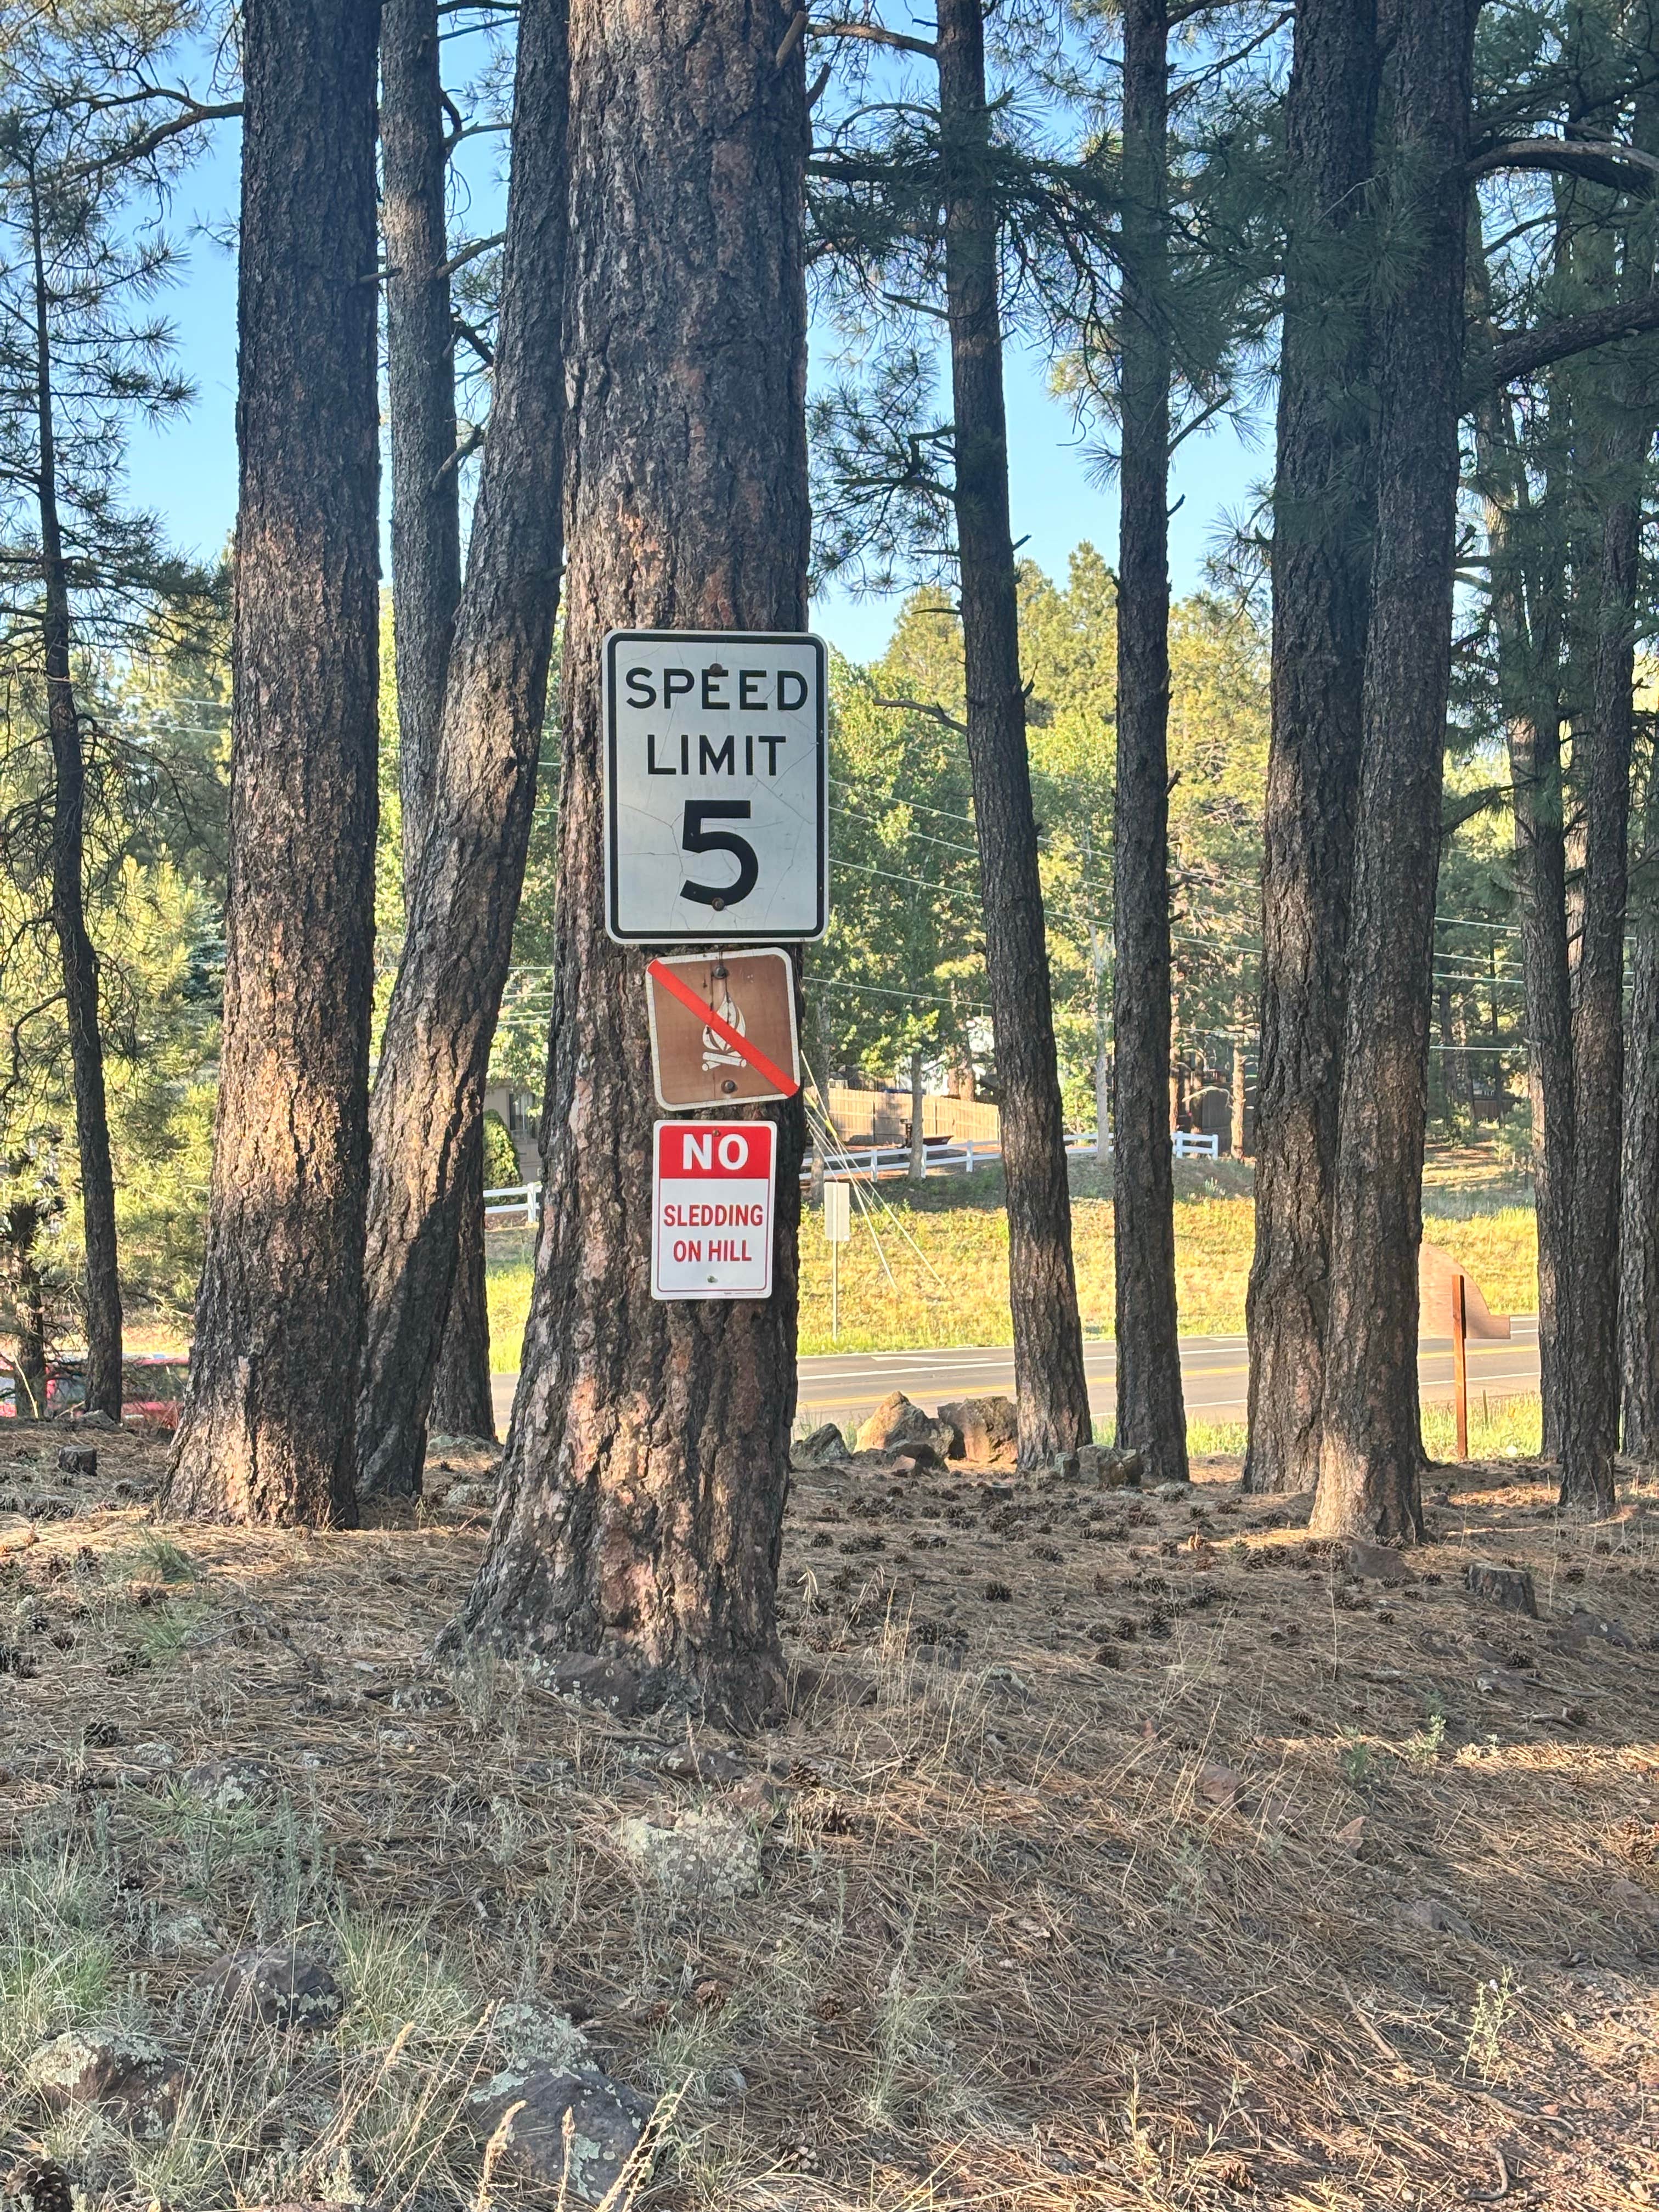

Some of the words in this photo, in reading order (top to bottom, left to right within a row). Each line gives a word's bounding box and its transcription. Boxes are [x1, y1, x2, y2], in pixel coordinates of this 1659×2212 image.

[626, 667, 808, 710] SPEED
[647, 734, 786, 776] LIMIT
[680, 799, 759, 907] 5
[682, 1133, 749, 1170] NO
[664, 1204, 763, 1227] SLEDDING
[673, 1240, 702, 1262] ON
[708, 1239, 752, 1262] HILL
